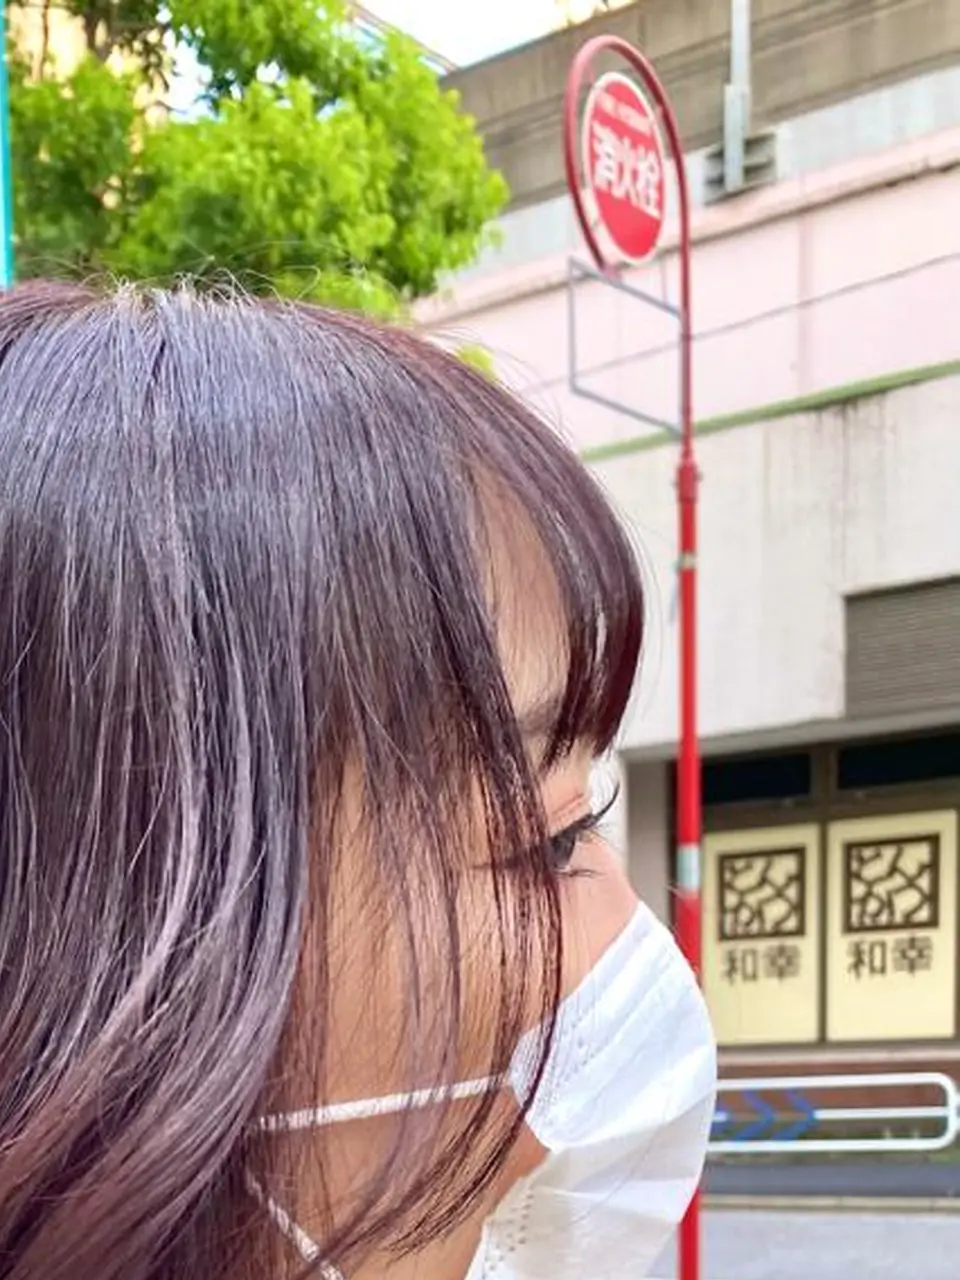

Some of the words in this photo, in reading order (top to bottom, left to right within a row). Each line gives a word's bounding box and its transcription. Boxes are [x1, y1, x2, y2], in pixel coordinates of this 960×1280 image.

[592, 120, 661, 220] 消火栓
[721, 943, 801, 985] 和幸
[846, 935, 934, 980] 和幸
